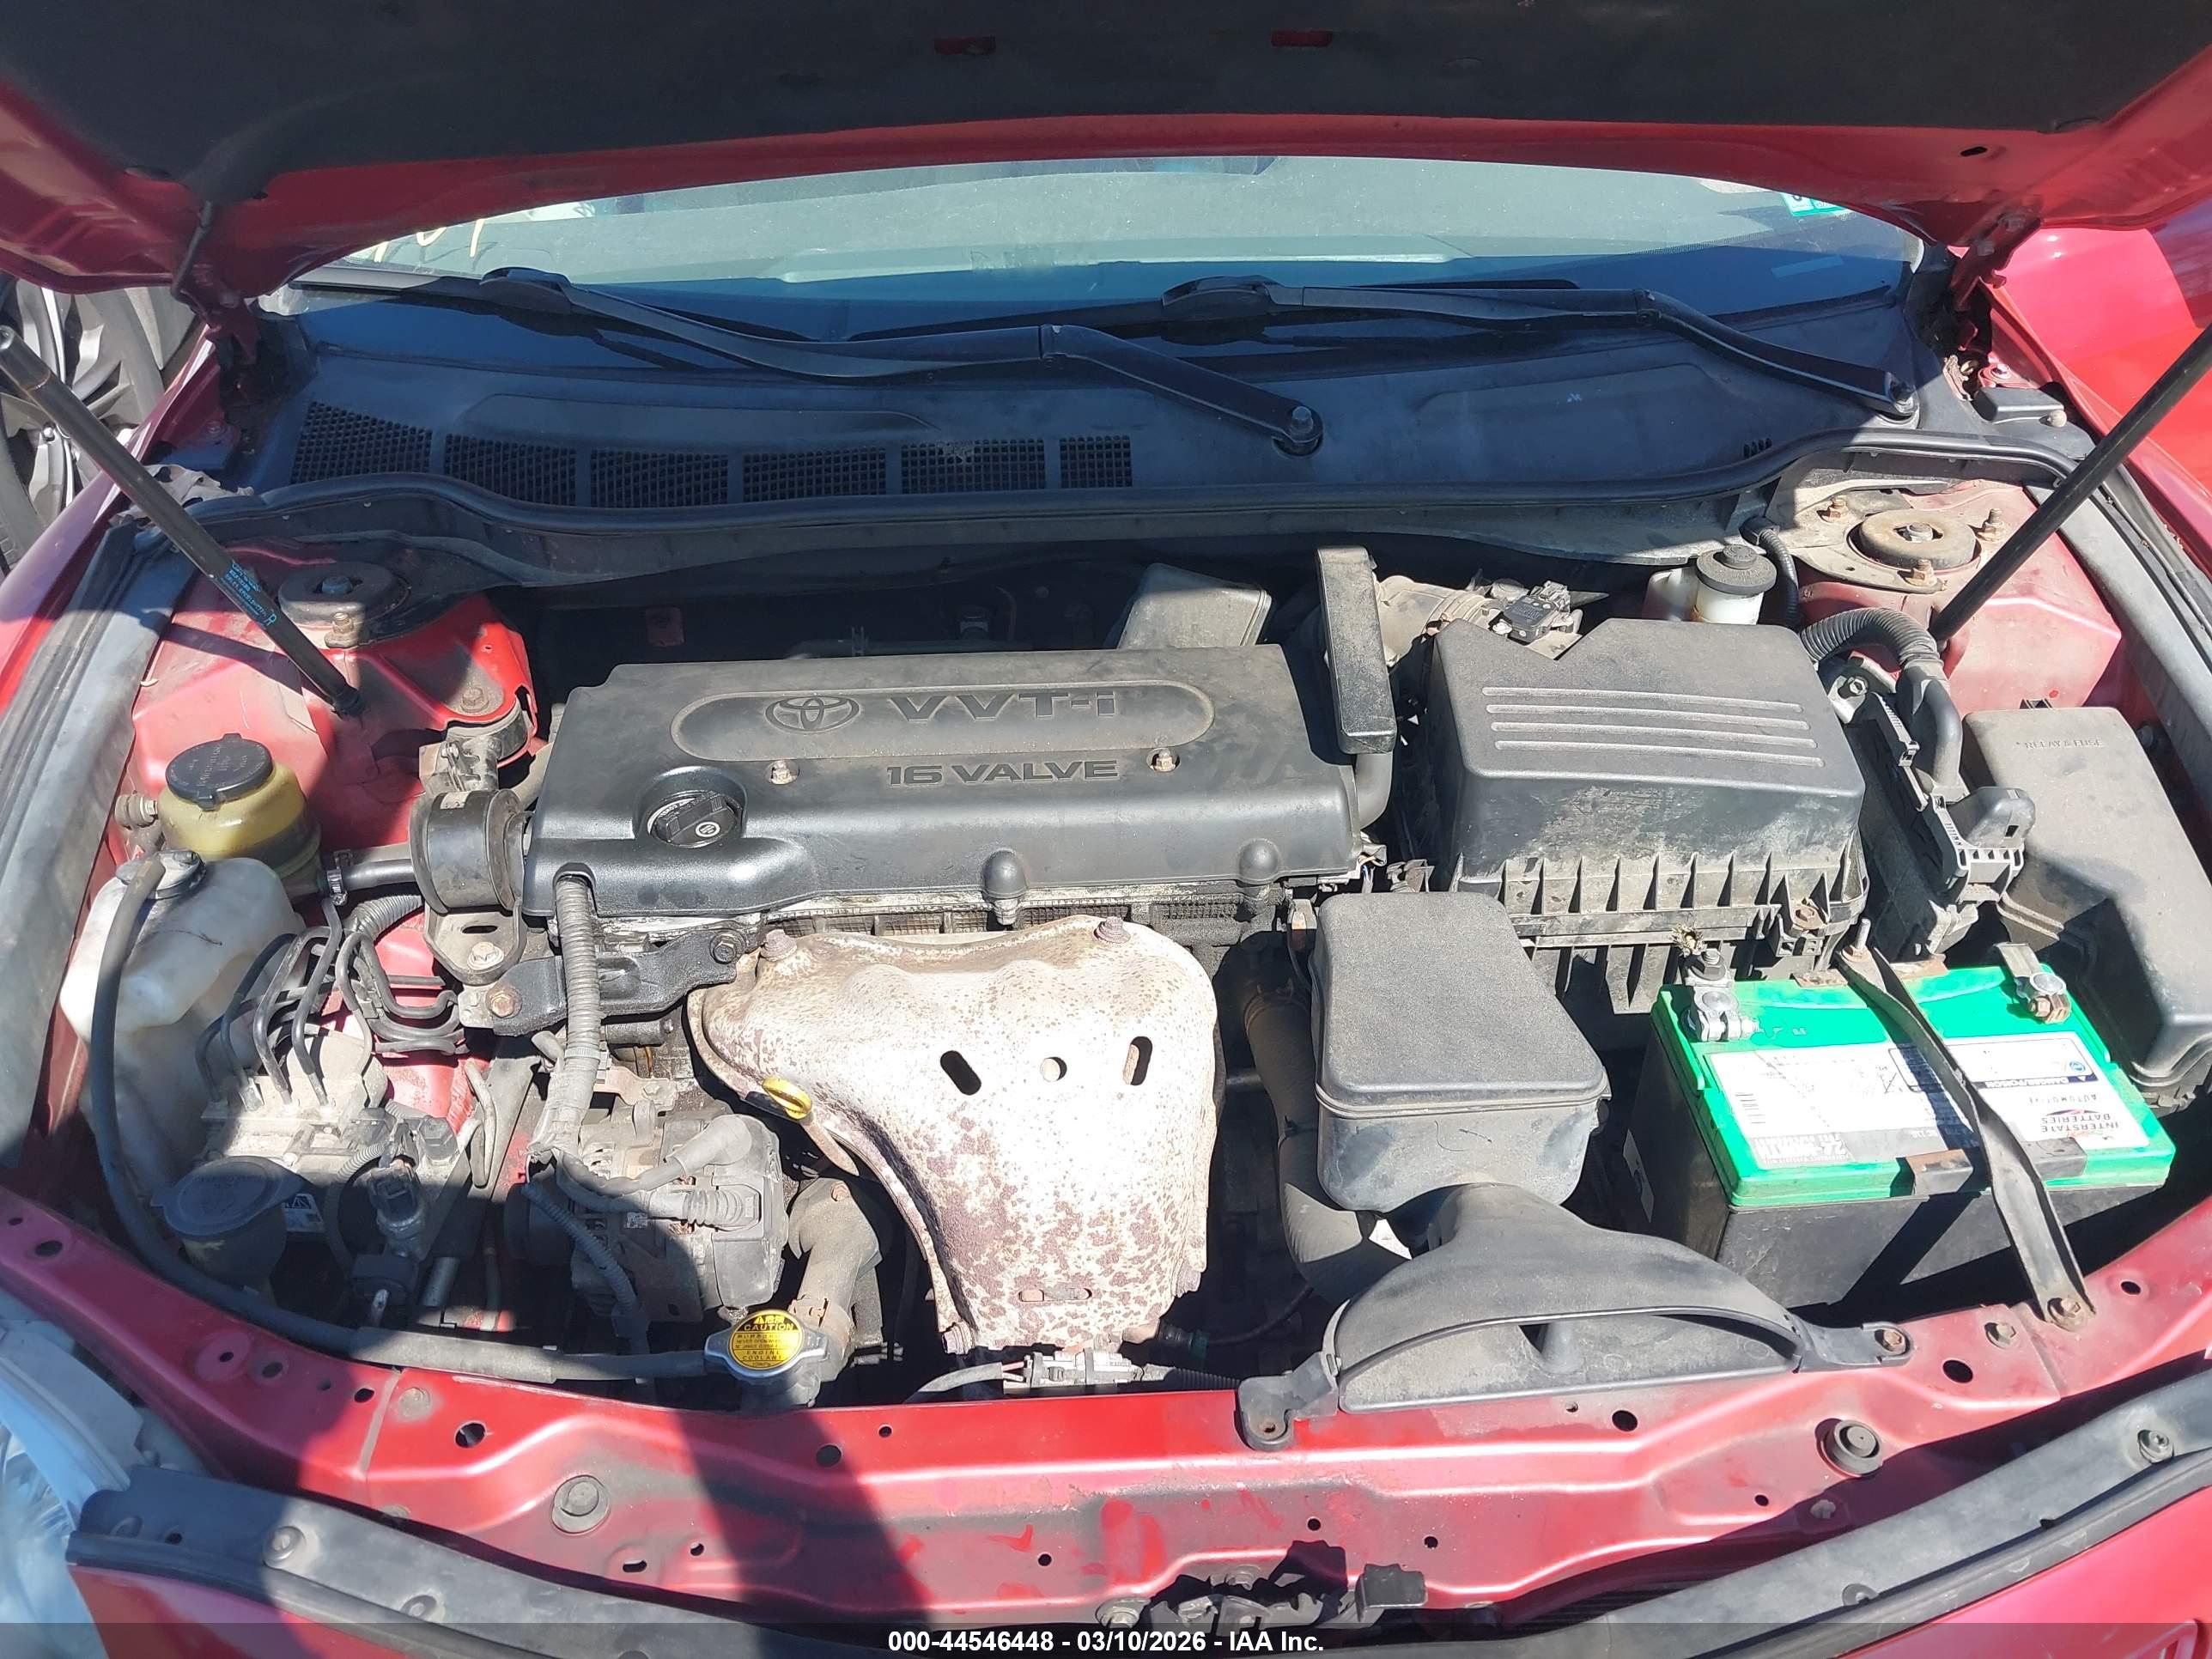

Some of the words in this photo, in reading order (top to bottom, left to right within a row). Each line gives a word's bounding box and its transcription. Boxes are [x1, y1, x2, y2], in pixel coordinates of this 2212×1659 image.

[890, 690, 1116, 722] VVT-i
[887, 764, 944, 786] 16
[948, 759, 1119, 783] VALVE
[2039, 1113, 2111, 1124] BATTERIES
[2039, 1121, 2119, 1133] INTERSTATE
